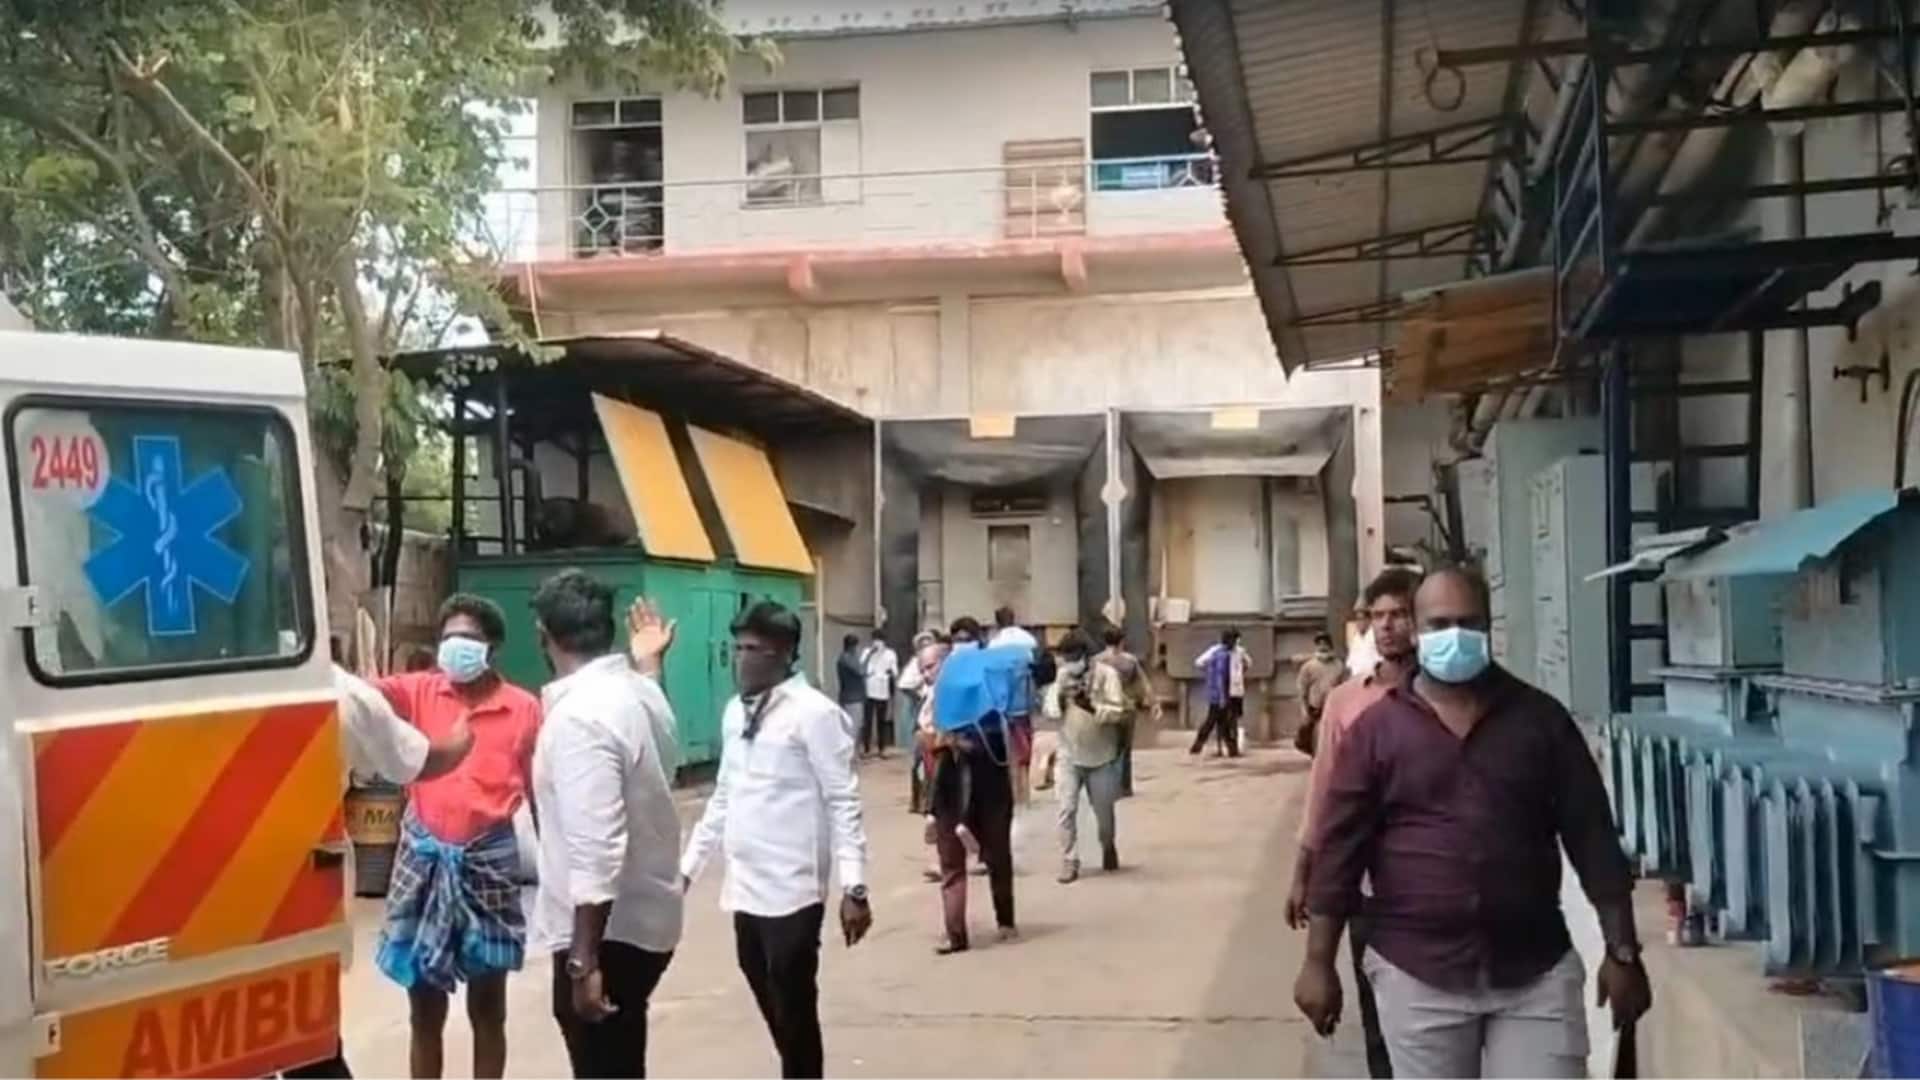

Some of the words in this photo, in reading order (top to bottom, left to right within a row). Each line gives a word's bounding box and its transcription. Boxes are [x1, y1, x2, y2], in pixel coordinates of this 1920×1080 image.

[30, 435, 100, 489] 2449
[44, 936, 171, 977] FORCE
[121, 968, 338, 1079] AMBU
